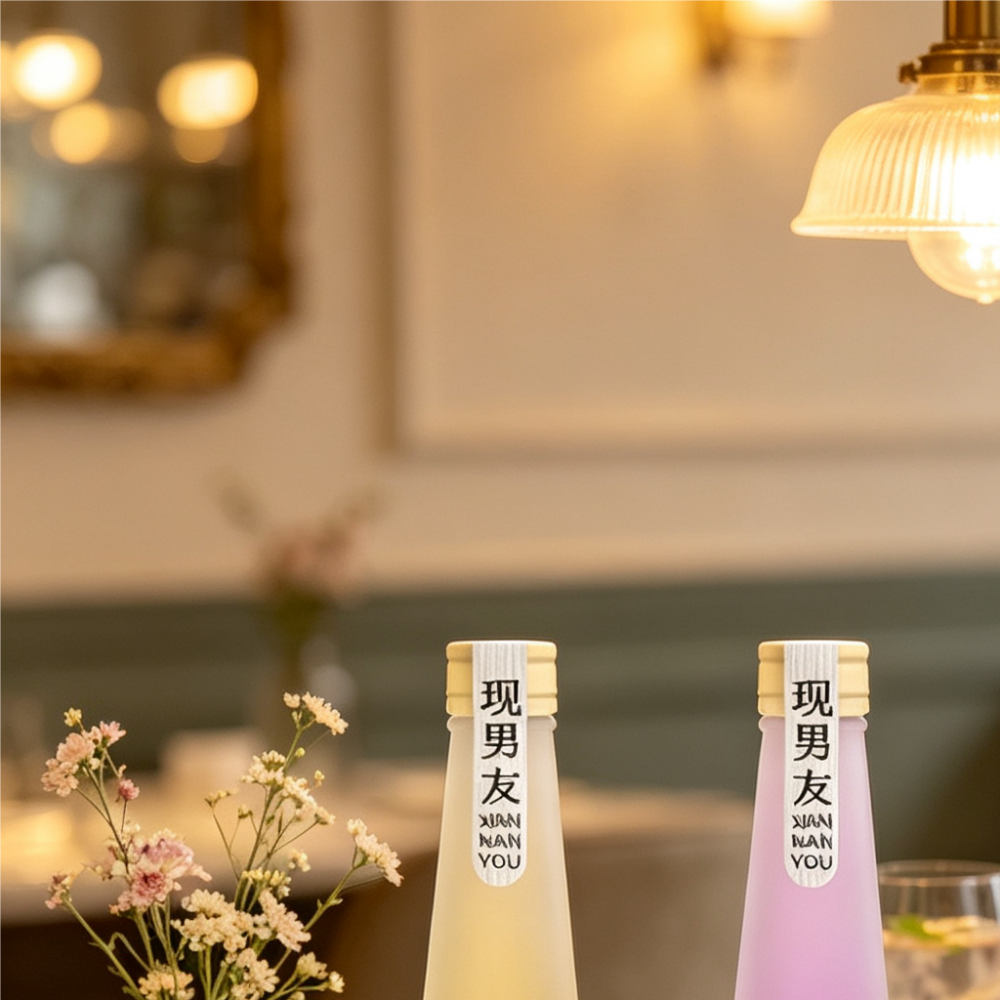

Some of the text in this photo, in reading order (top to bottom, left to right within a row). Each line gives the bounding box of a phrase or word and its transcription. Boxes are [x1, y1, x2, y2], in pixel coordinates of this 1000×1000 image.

[480, 679, 522, 806] 现男友
[791, 679, 834, 806] 现男友
[479, 853, 521, 870] YOU
[791, 853, 833, 870] YOU
